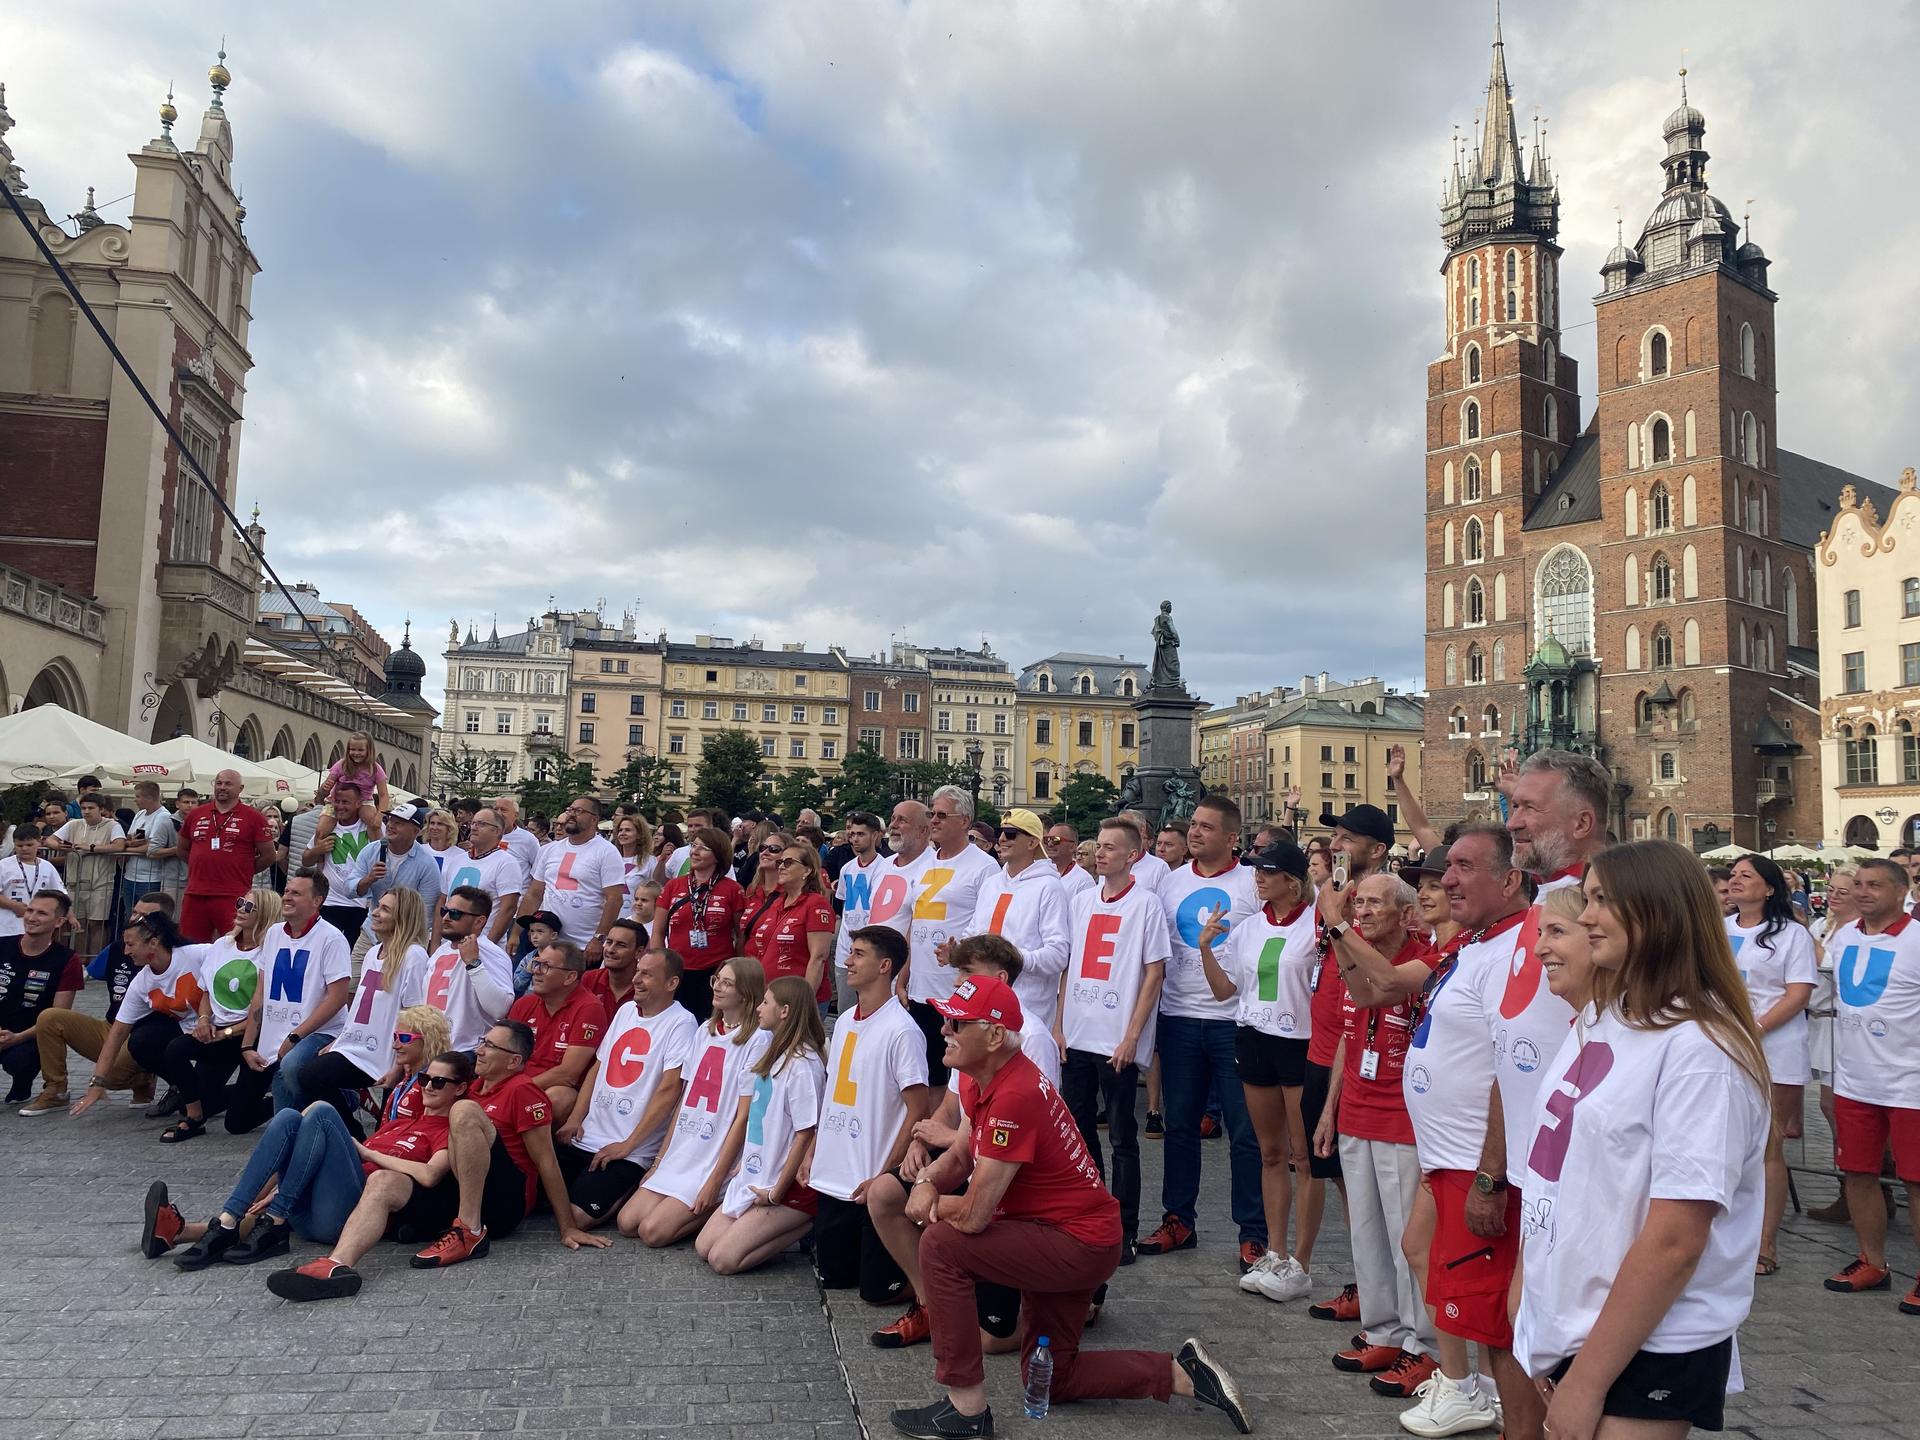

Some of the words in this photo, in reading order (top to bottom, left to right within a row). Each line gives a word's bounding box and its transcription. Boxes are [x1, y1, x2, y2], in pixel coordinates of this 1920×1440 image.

[331, 832, 369, 865] W
[555, 852, 578, 891] L
[844, 873, 871, 911] W
[867, 874, 908, 925] D
[913, 868, 955, 920] Z
[1176, 886, 1232, 950] C
[269, 948, 310, 1003] N
[1081, 914, 1122, 981] E
[1258, 937, 1287, 1001] I
[213, 958, 257, 1010] O
[354, 969, 385, 1024] T
[426, 953, 459, 1011] E
[1839, 945, 1896, 1008] U
[606, 1027, 651, 1088] C
[685, 1046, 727, 1113] A
[833, 1031, 857, 1107] L
